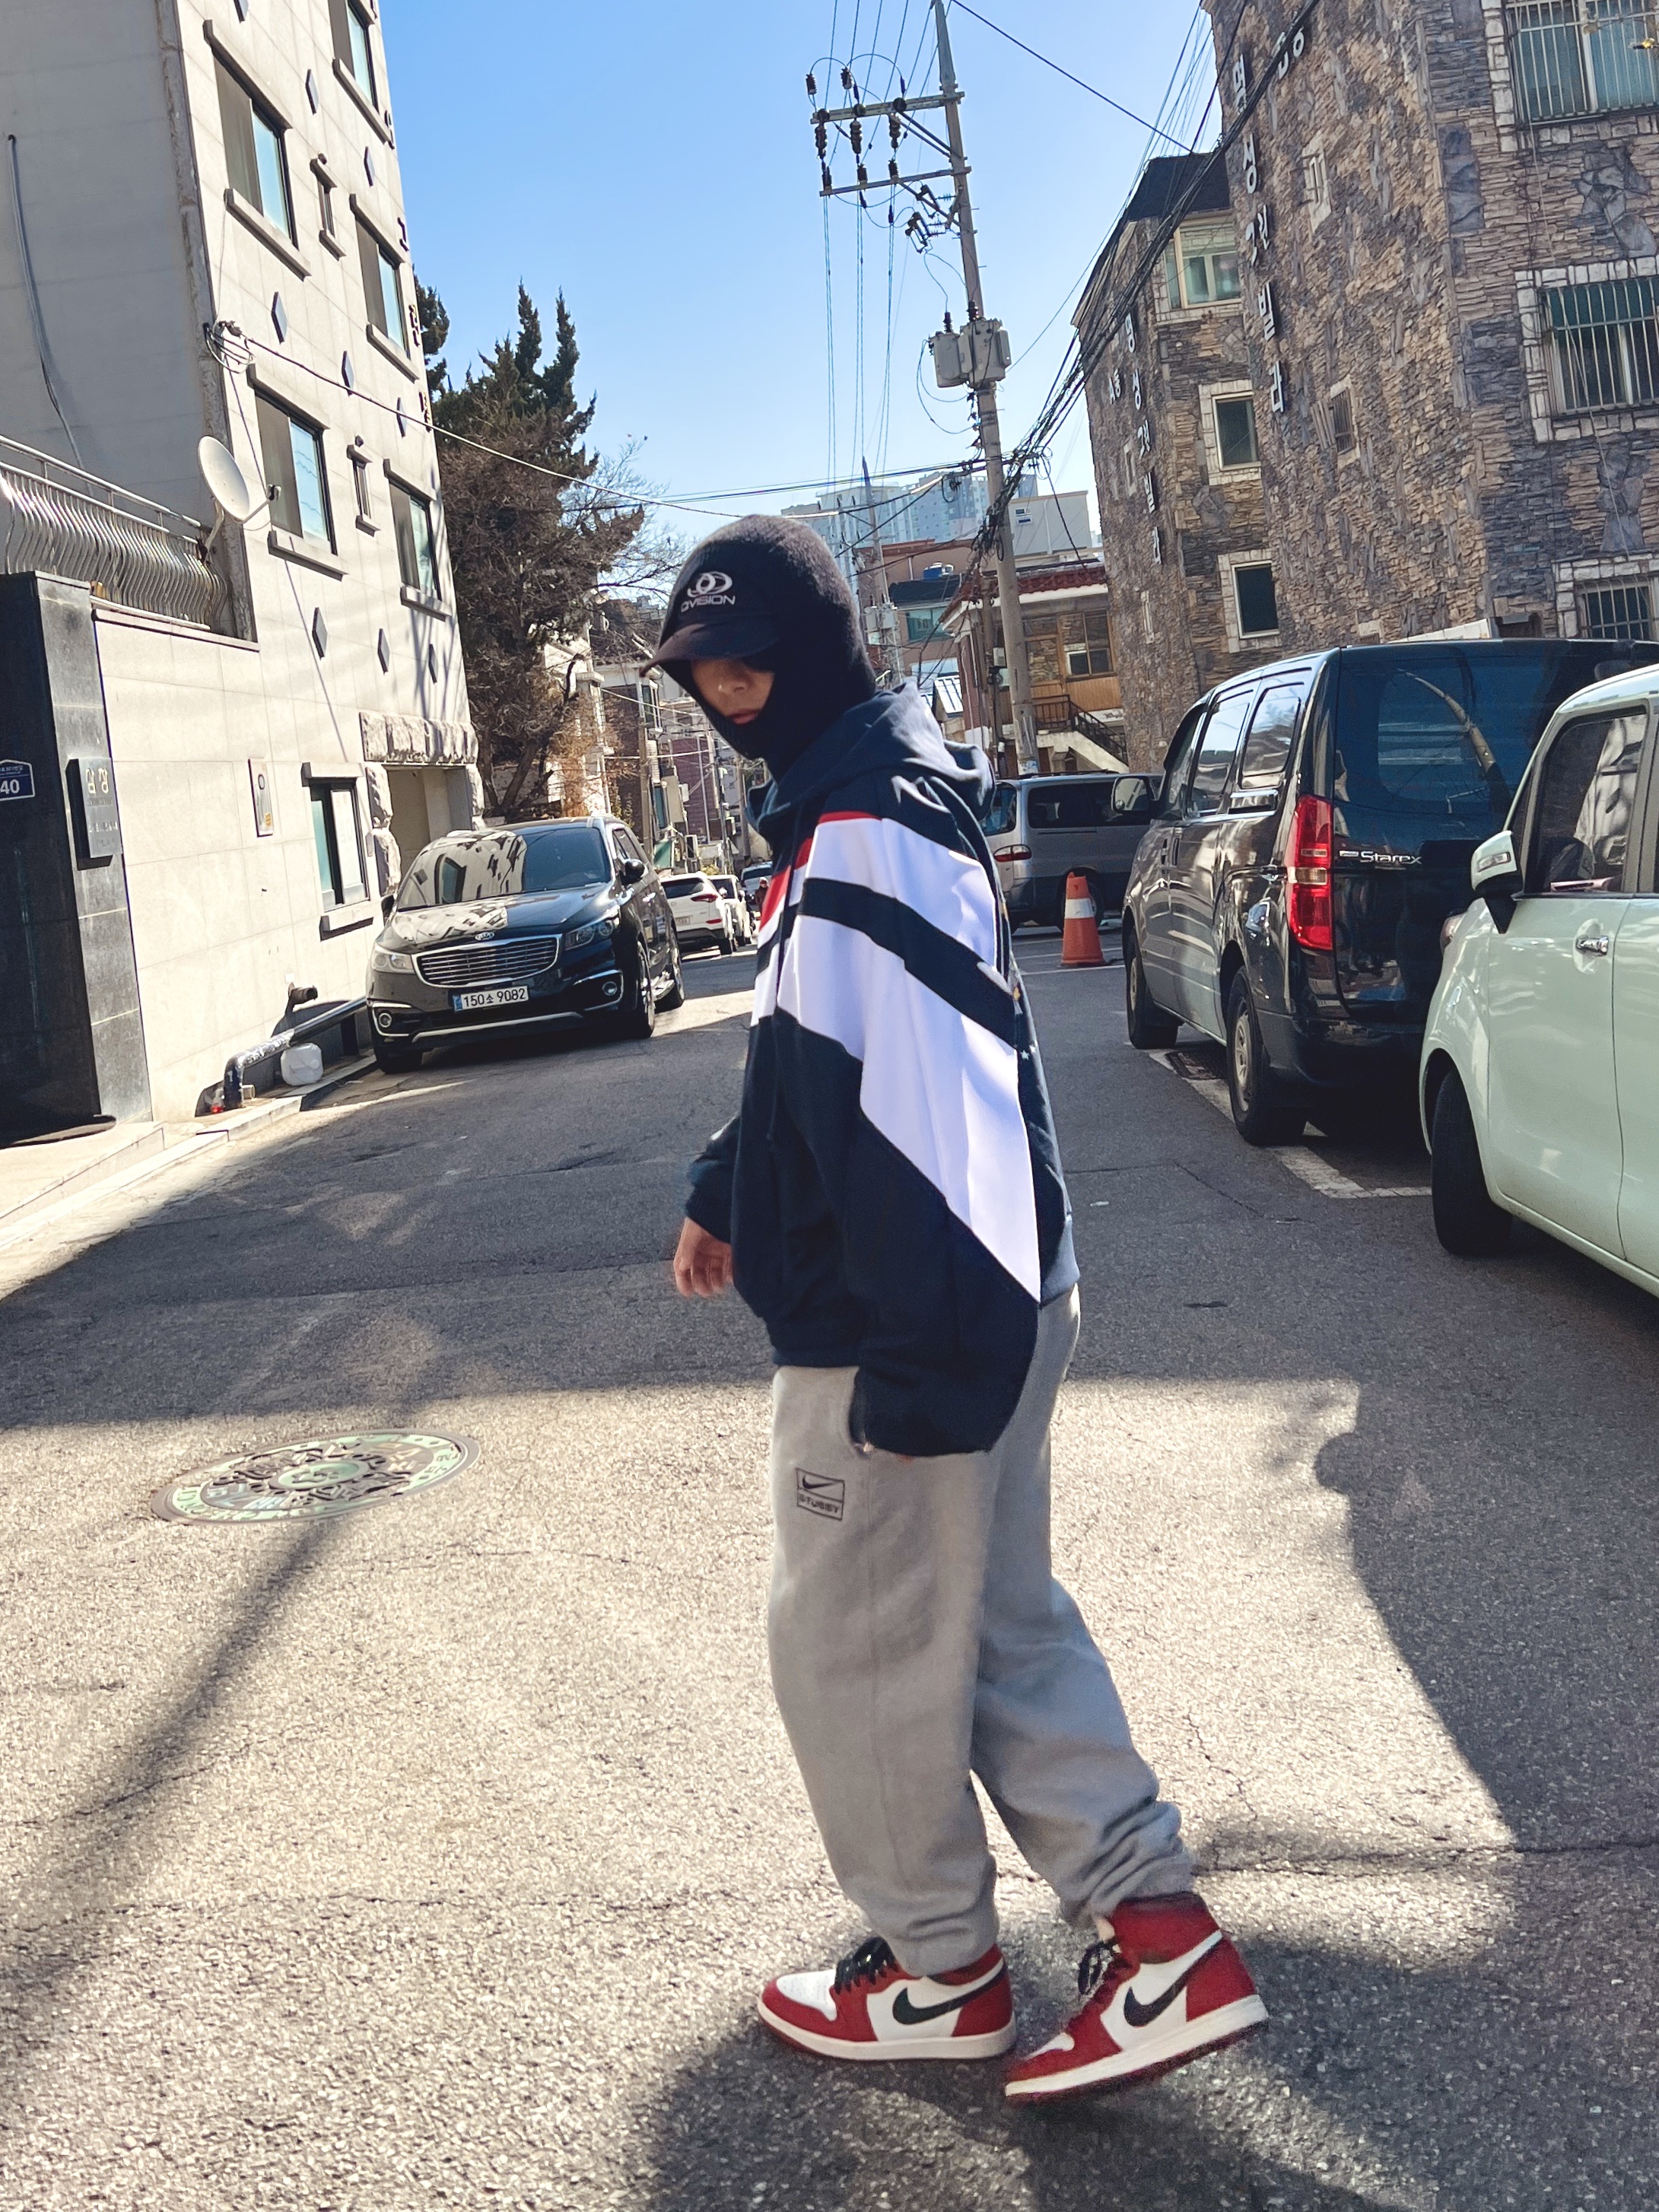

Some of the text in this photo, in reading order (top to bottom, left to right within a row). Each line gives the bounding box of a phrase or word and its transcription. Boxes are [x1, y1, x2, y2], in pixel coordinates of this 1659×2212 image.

[1359, 850, 1422, 864] Starex
[463, 987, 526, 1007] 150소 9082
